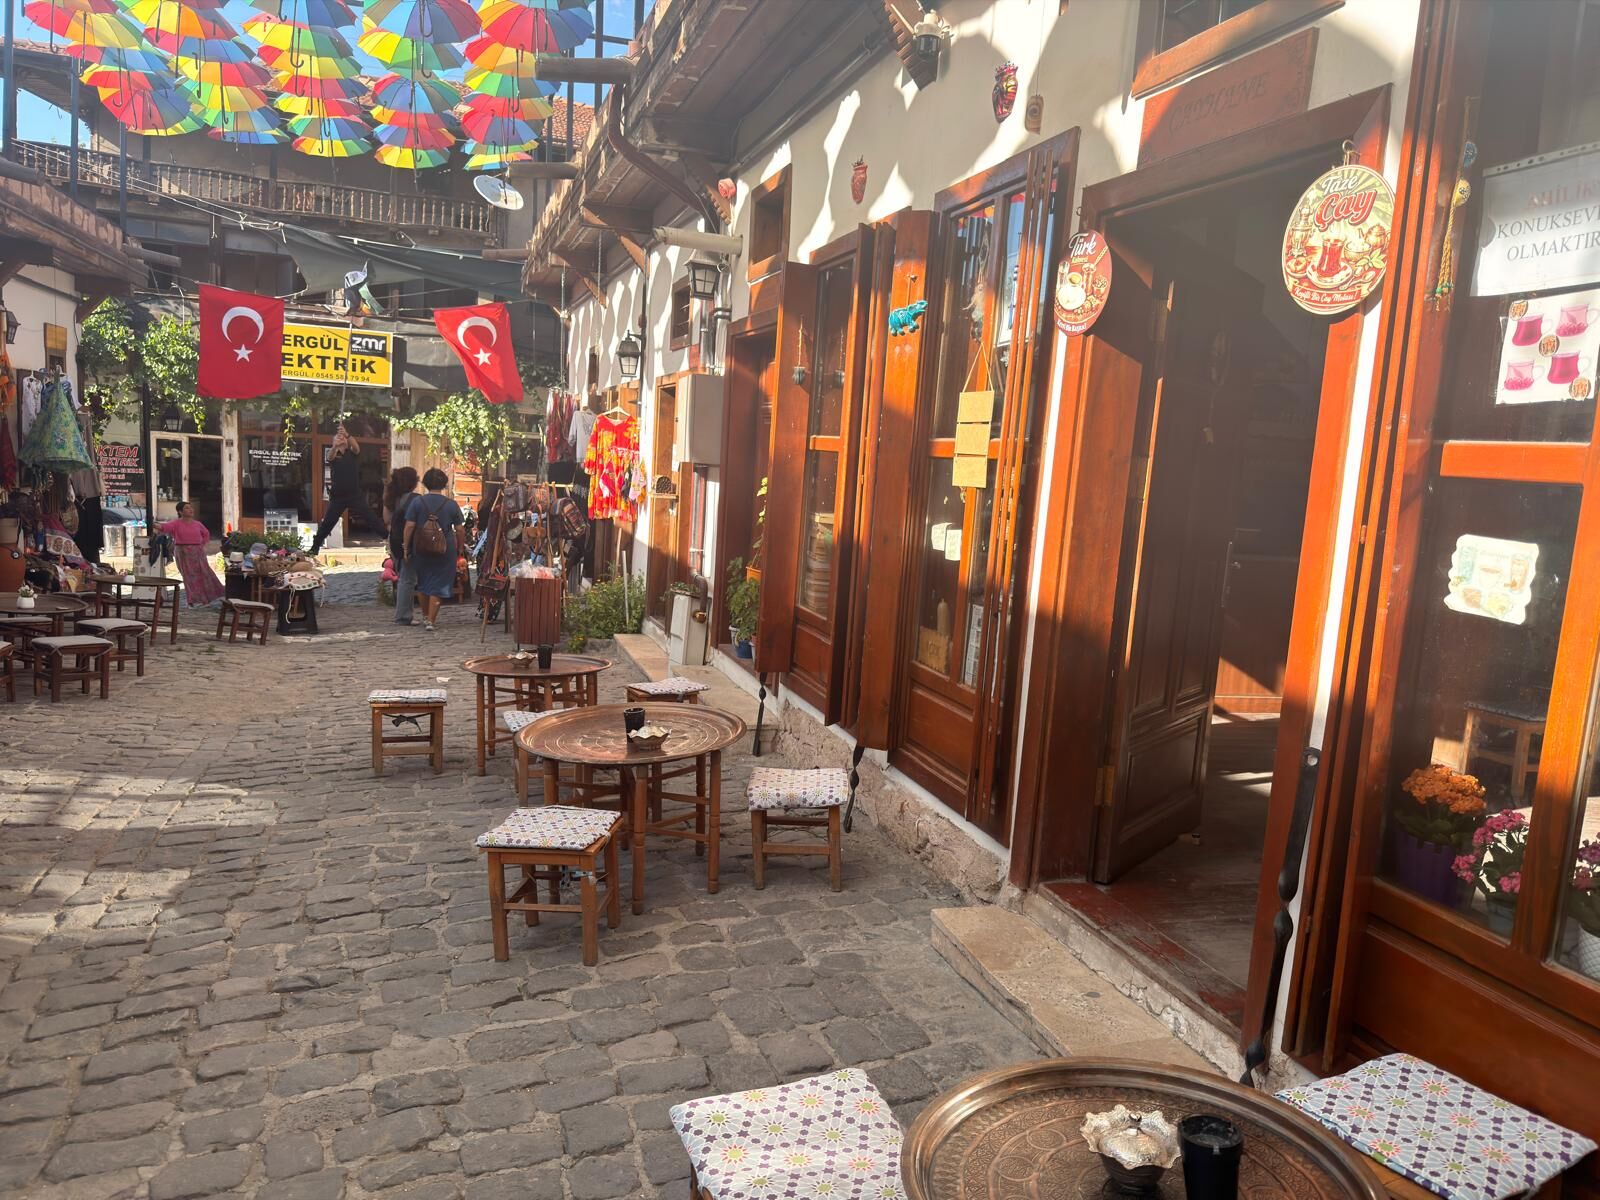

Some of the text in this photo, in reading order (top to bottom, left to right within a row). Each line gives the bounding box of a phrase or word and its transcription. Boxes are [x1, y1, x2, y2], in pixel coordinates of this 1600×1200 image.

[1322, 175, 1359, 196] Taze
[1314, 189, 1377, 232] Çay
[1497, 204, 1600, 240] KONUKSEV
[1068, 232, 1097, 259] Türk
[281, 334, 343, 351] ERGÜL
[352, 337, 386, 351] zmr
[97, 445, 138, 457] KTEM
